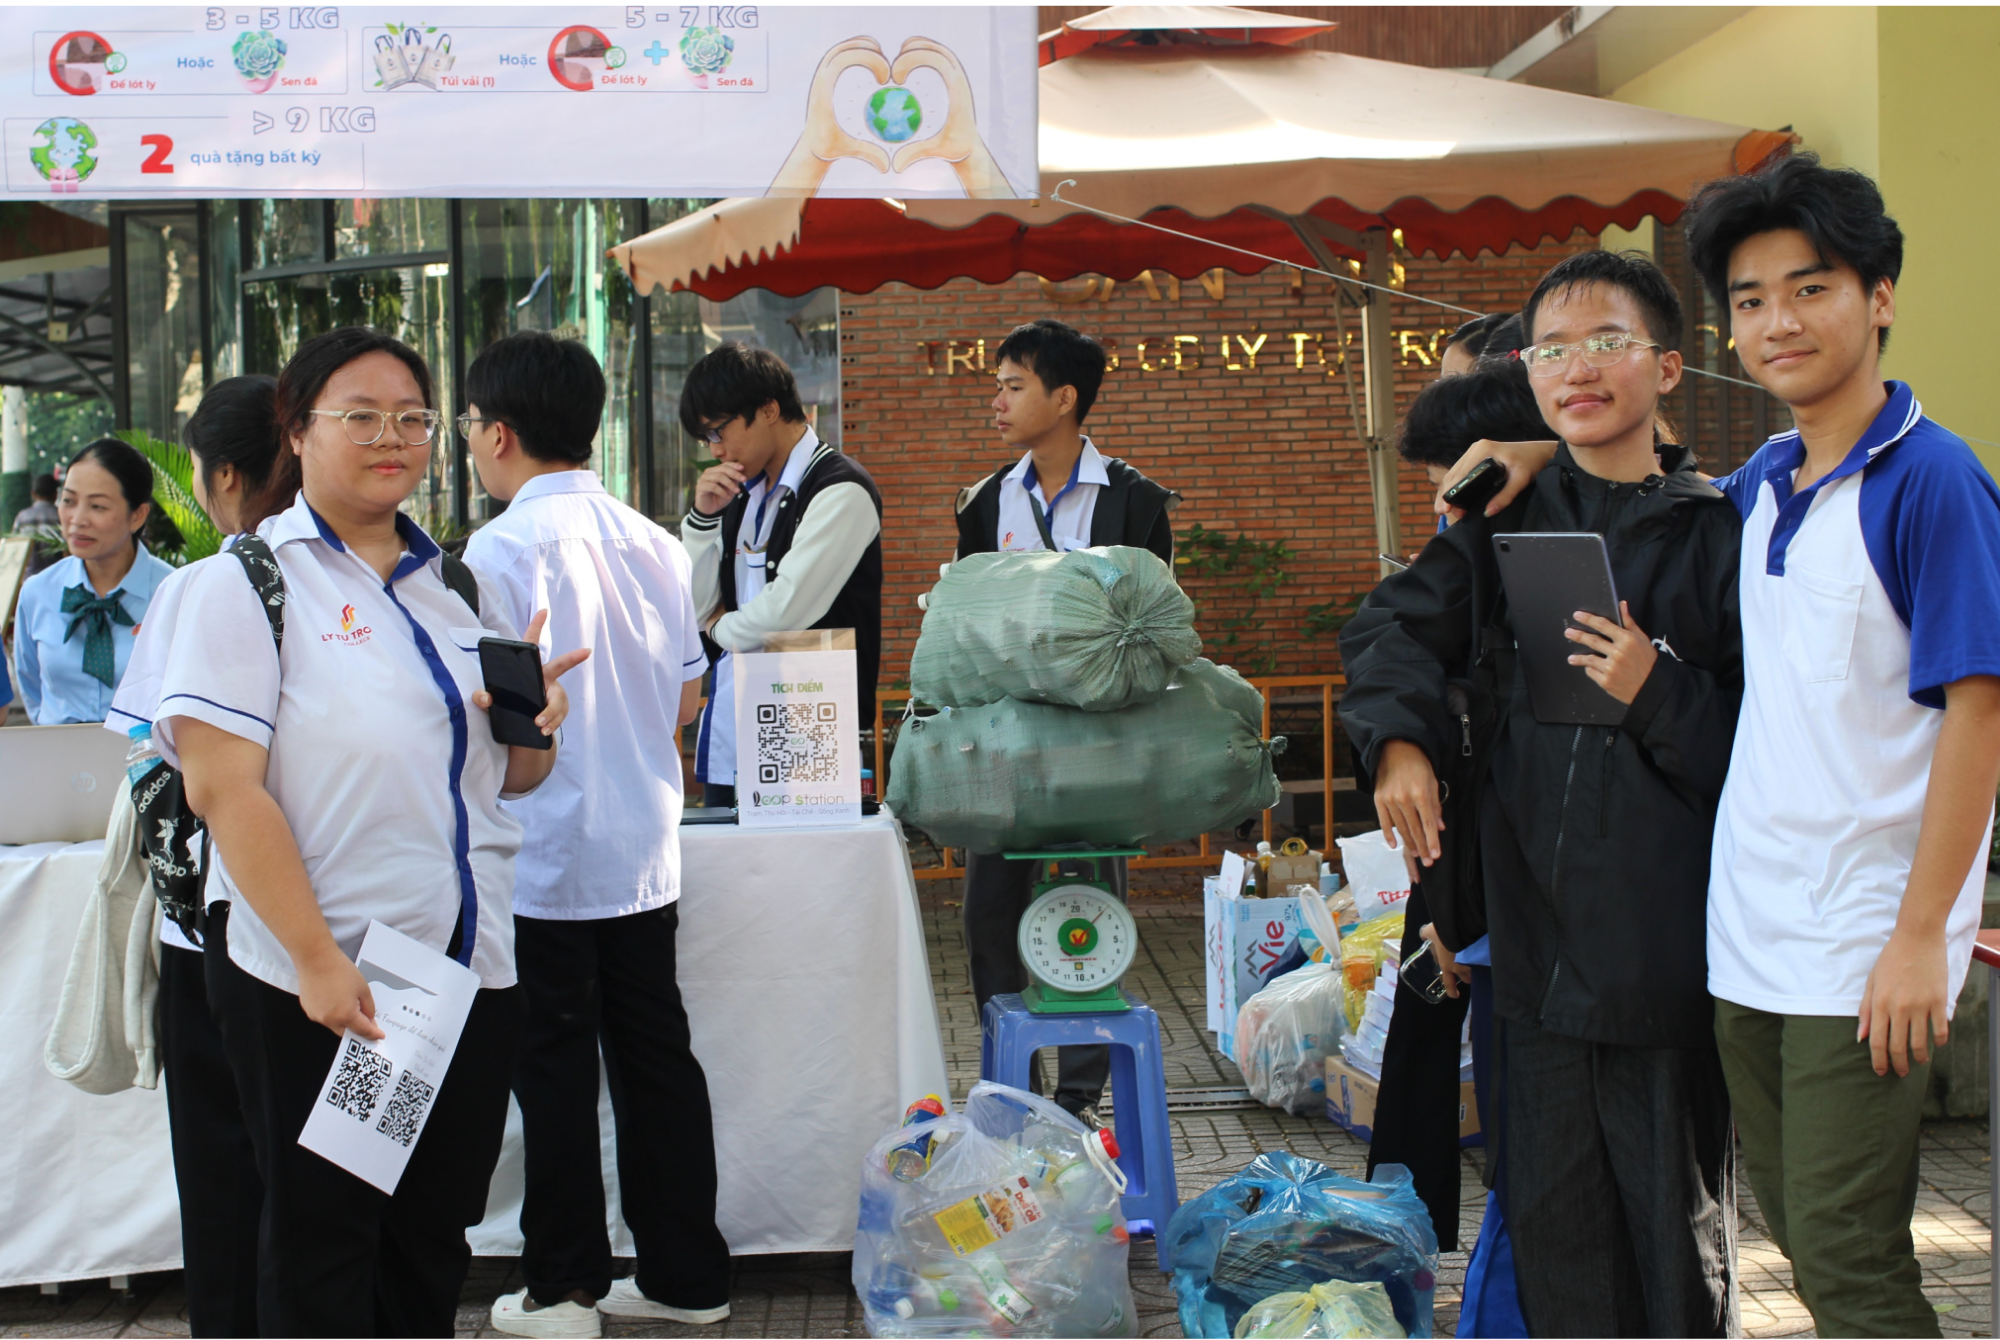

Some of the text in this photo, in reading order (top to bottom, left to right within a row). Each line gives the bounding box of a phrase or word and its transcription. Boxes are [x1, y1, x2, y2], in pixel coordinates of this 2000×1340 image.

[206, 6, 339, 31] 3 - 5 KG
[626, 6, 759, 28] 5 - 7 KG
[177, 57, 214, 70] Hoặc
[499, 53, 537, 67] Hoặc
[110, 77, 156, 91] Đế lót ly
[281, 76, 318, 87] Sen đá
[440, 75, 495, 88] Túi vải (1)
[601, 73, 647, 87] Đế lót ly
[717, 76, 754, 87] Sen đá
[253, 106, 376, 135] > 9 KG
[140, 133, 321, 173] 2 quà tặng bất kỳ
[771, 681, 794, 693] TÍCH
[138, 770, 171, 814] adidas
[1071, 904, 1081, 913] 20
[1033, 937, 1043, 946] 15
[1258, 920, 1285, 975] Vie
[1075, 973, 1085, 982] 10
[1025, 1209, 1037, 1223] Oil
